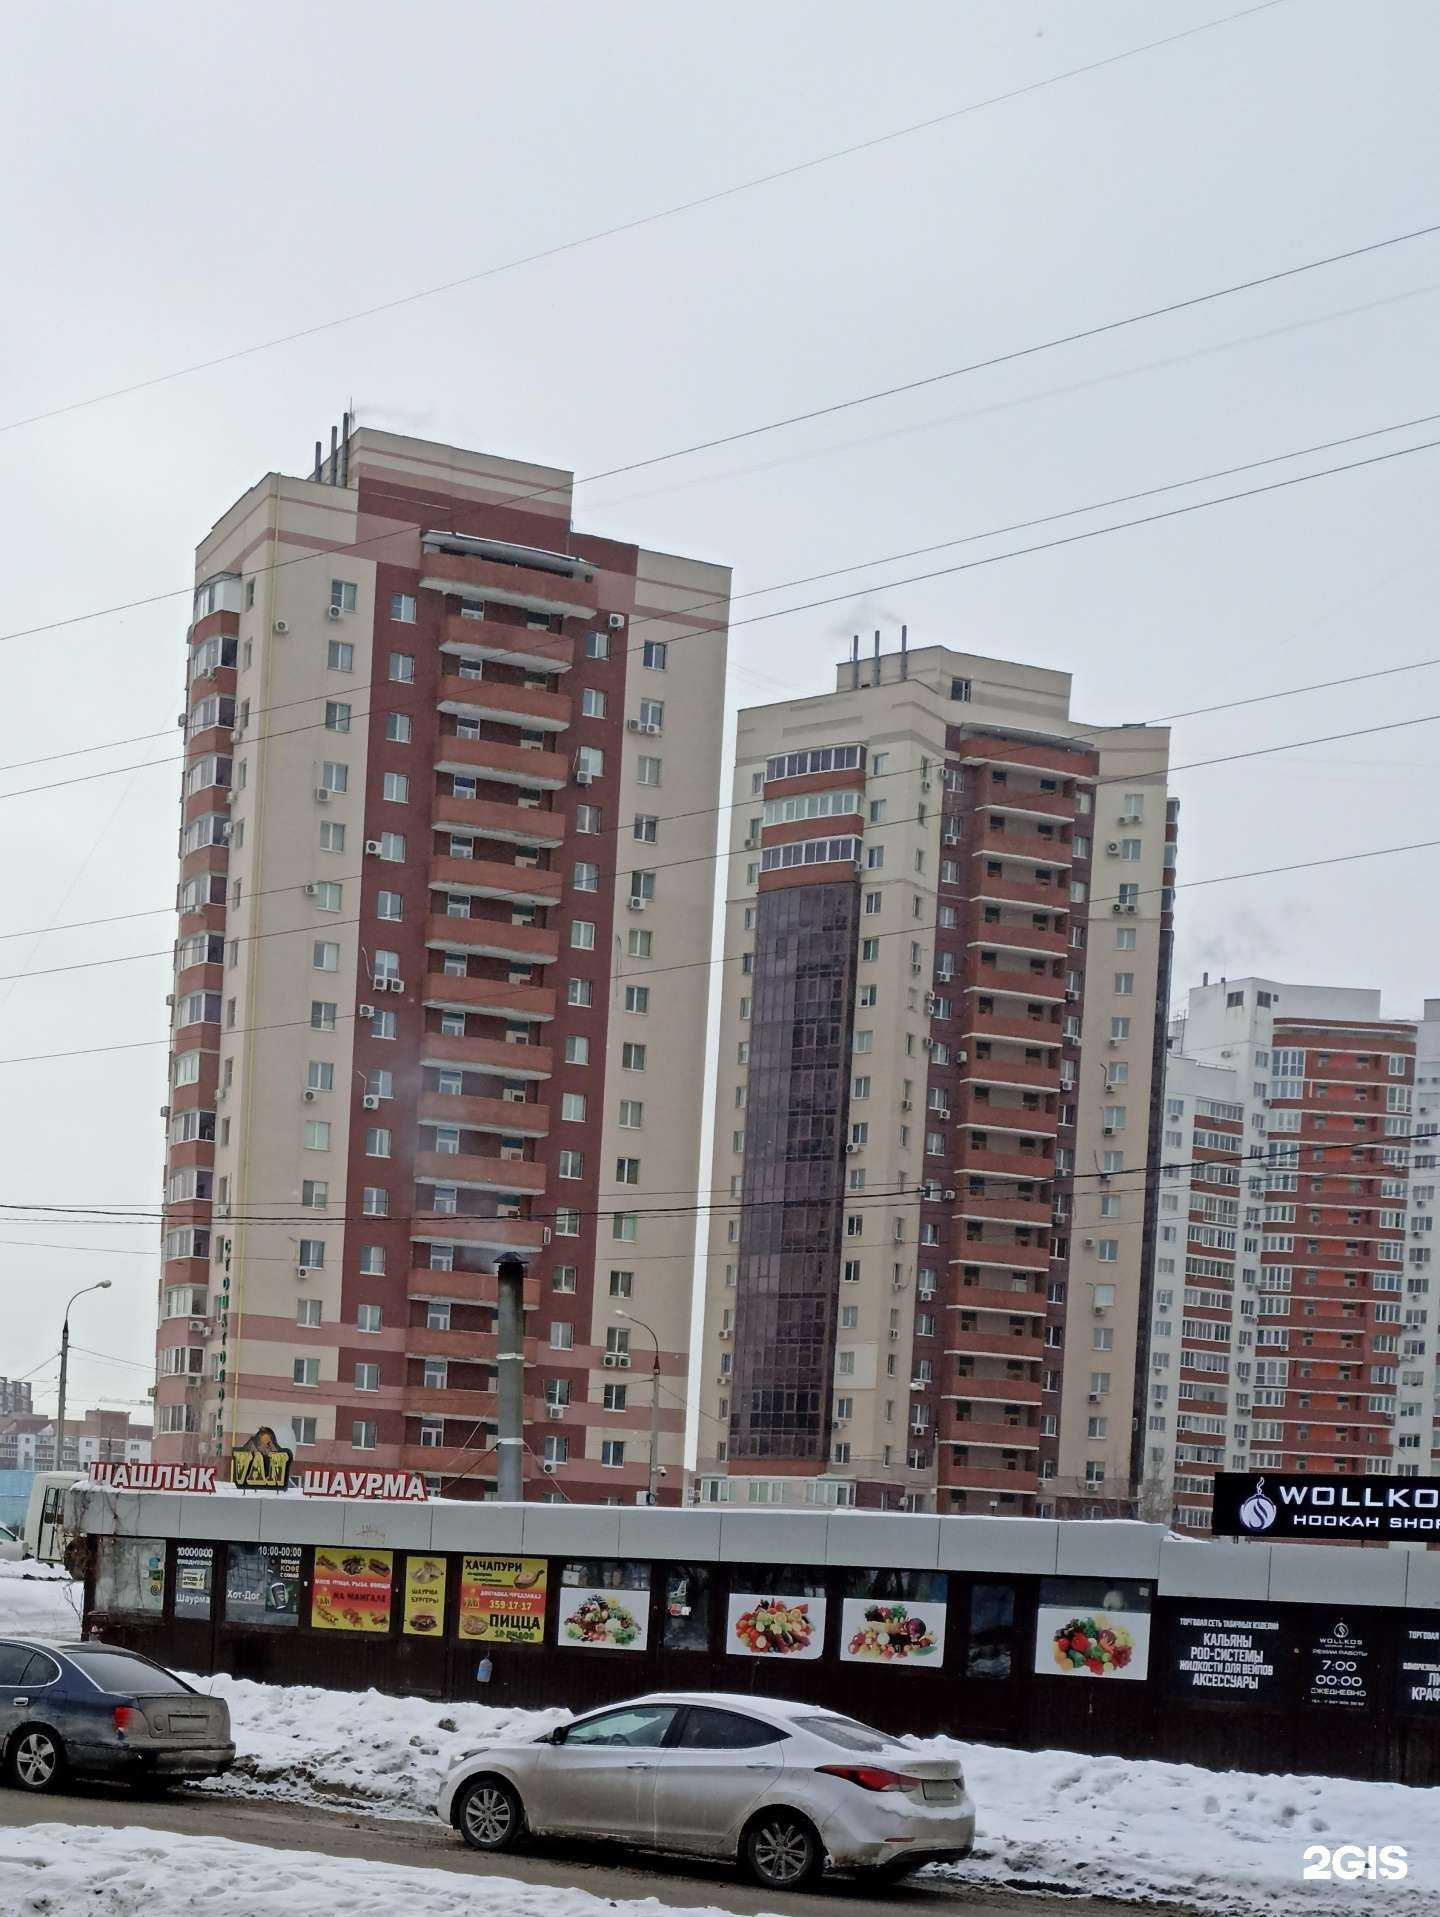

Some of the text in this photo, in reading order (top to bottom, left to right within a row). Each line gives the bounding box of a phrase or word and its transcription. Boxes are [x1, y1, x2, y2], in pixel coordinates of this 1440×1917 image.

[303, 1470, 425, 1499] ШАУРМА
[1279, 1485, 1439, 1508] WOLLKO
[1293, 1514, 1379, 1528] HOOKAH
[465, 1560, 522, 1572] ХАЧАПУРИ
[490, 1614, 541, 1631] ПИЦЦА
[1203, 1633, 1253, 1648] КАЛЬЯНЫ
[1180, 1660, 1274, 1676] ЖИДКОСТИ ДЛЯ ВЕЙПОВ
[1321, 1660, 1357, 1672] 7:00
[1192, 1673, 1259, 1689] АКСЕССУАРЫ
[1315, 1674, 1363, 1687] 00:00
